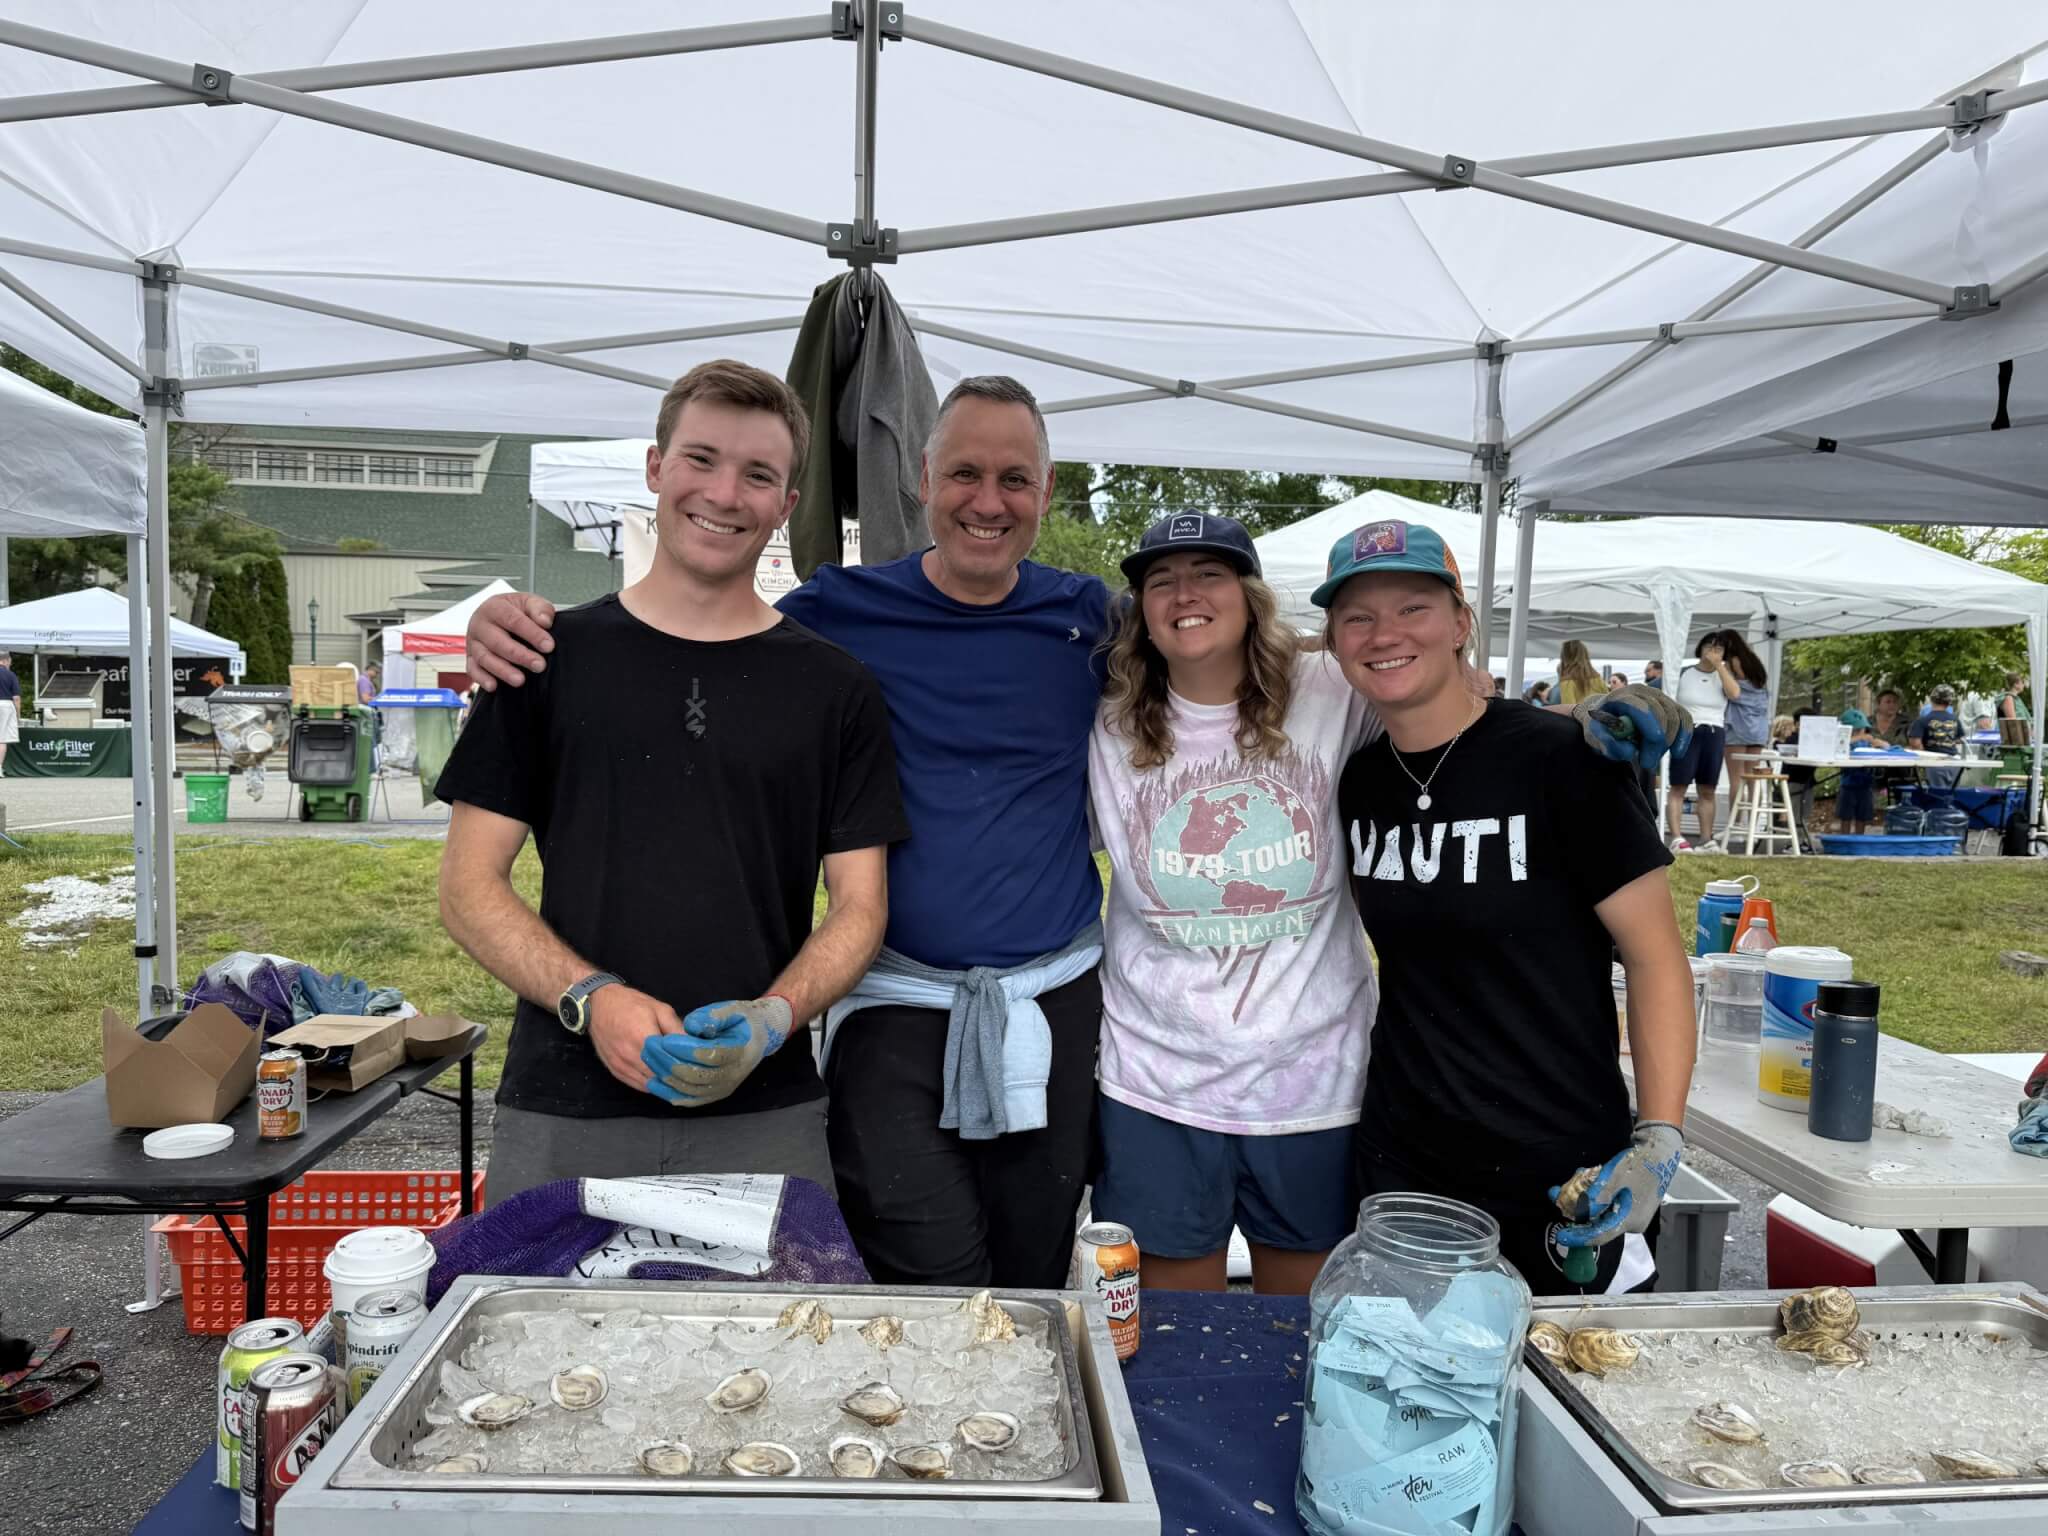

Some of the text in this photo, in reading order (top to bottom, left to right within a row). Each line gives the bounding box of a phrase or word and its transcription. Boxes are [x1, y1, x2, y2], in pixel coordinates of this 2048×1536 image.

[761, 577, 792, 585] KIMCHI
[1155, 830, 1313, 879] 1979 TOUR
[1174, 910, 1304, 944] VAN HALEN
[263, 1097, 283, 1105] DRY
[1111, 1298, 1136, 1313] DRY
[1438, 1442, 1466, 1465] RAW
[1419, 1490, 1444, 1502] FESTIVAL
